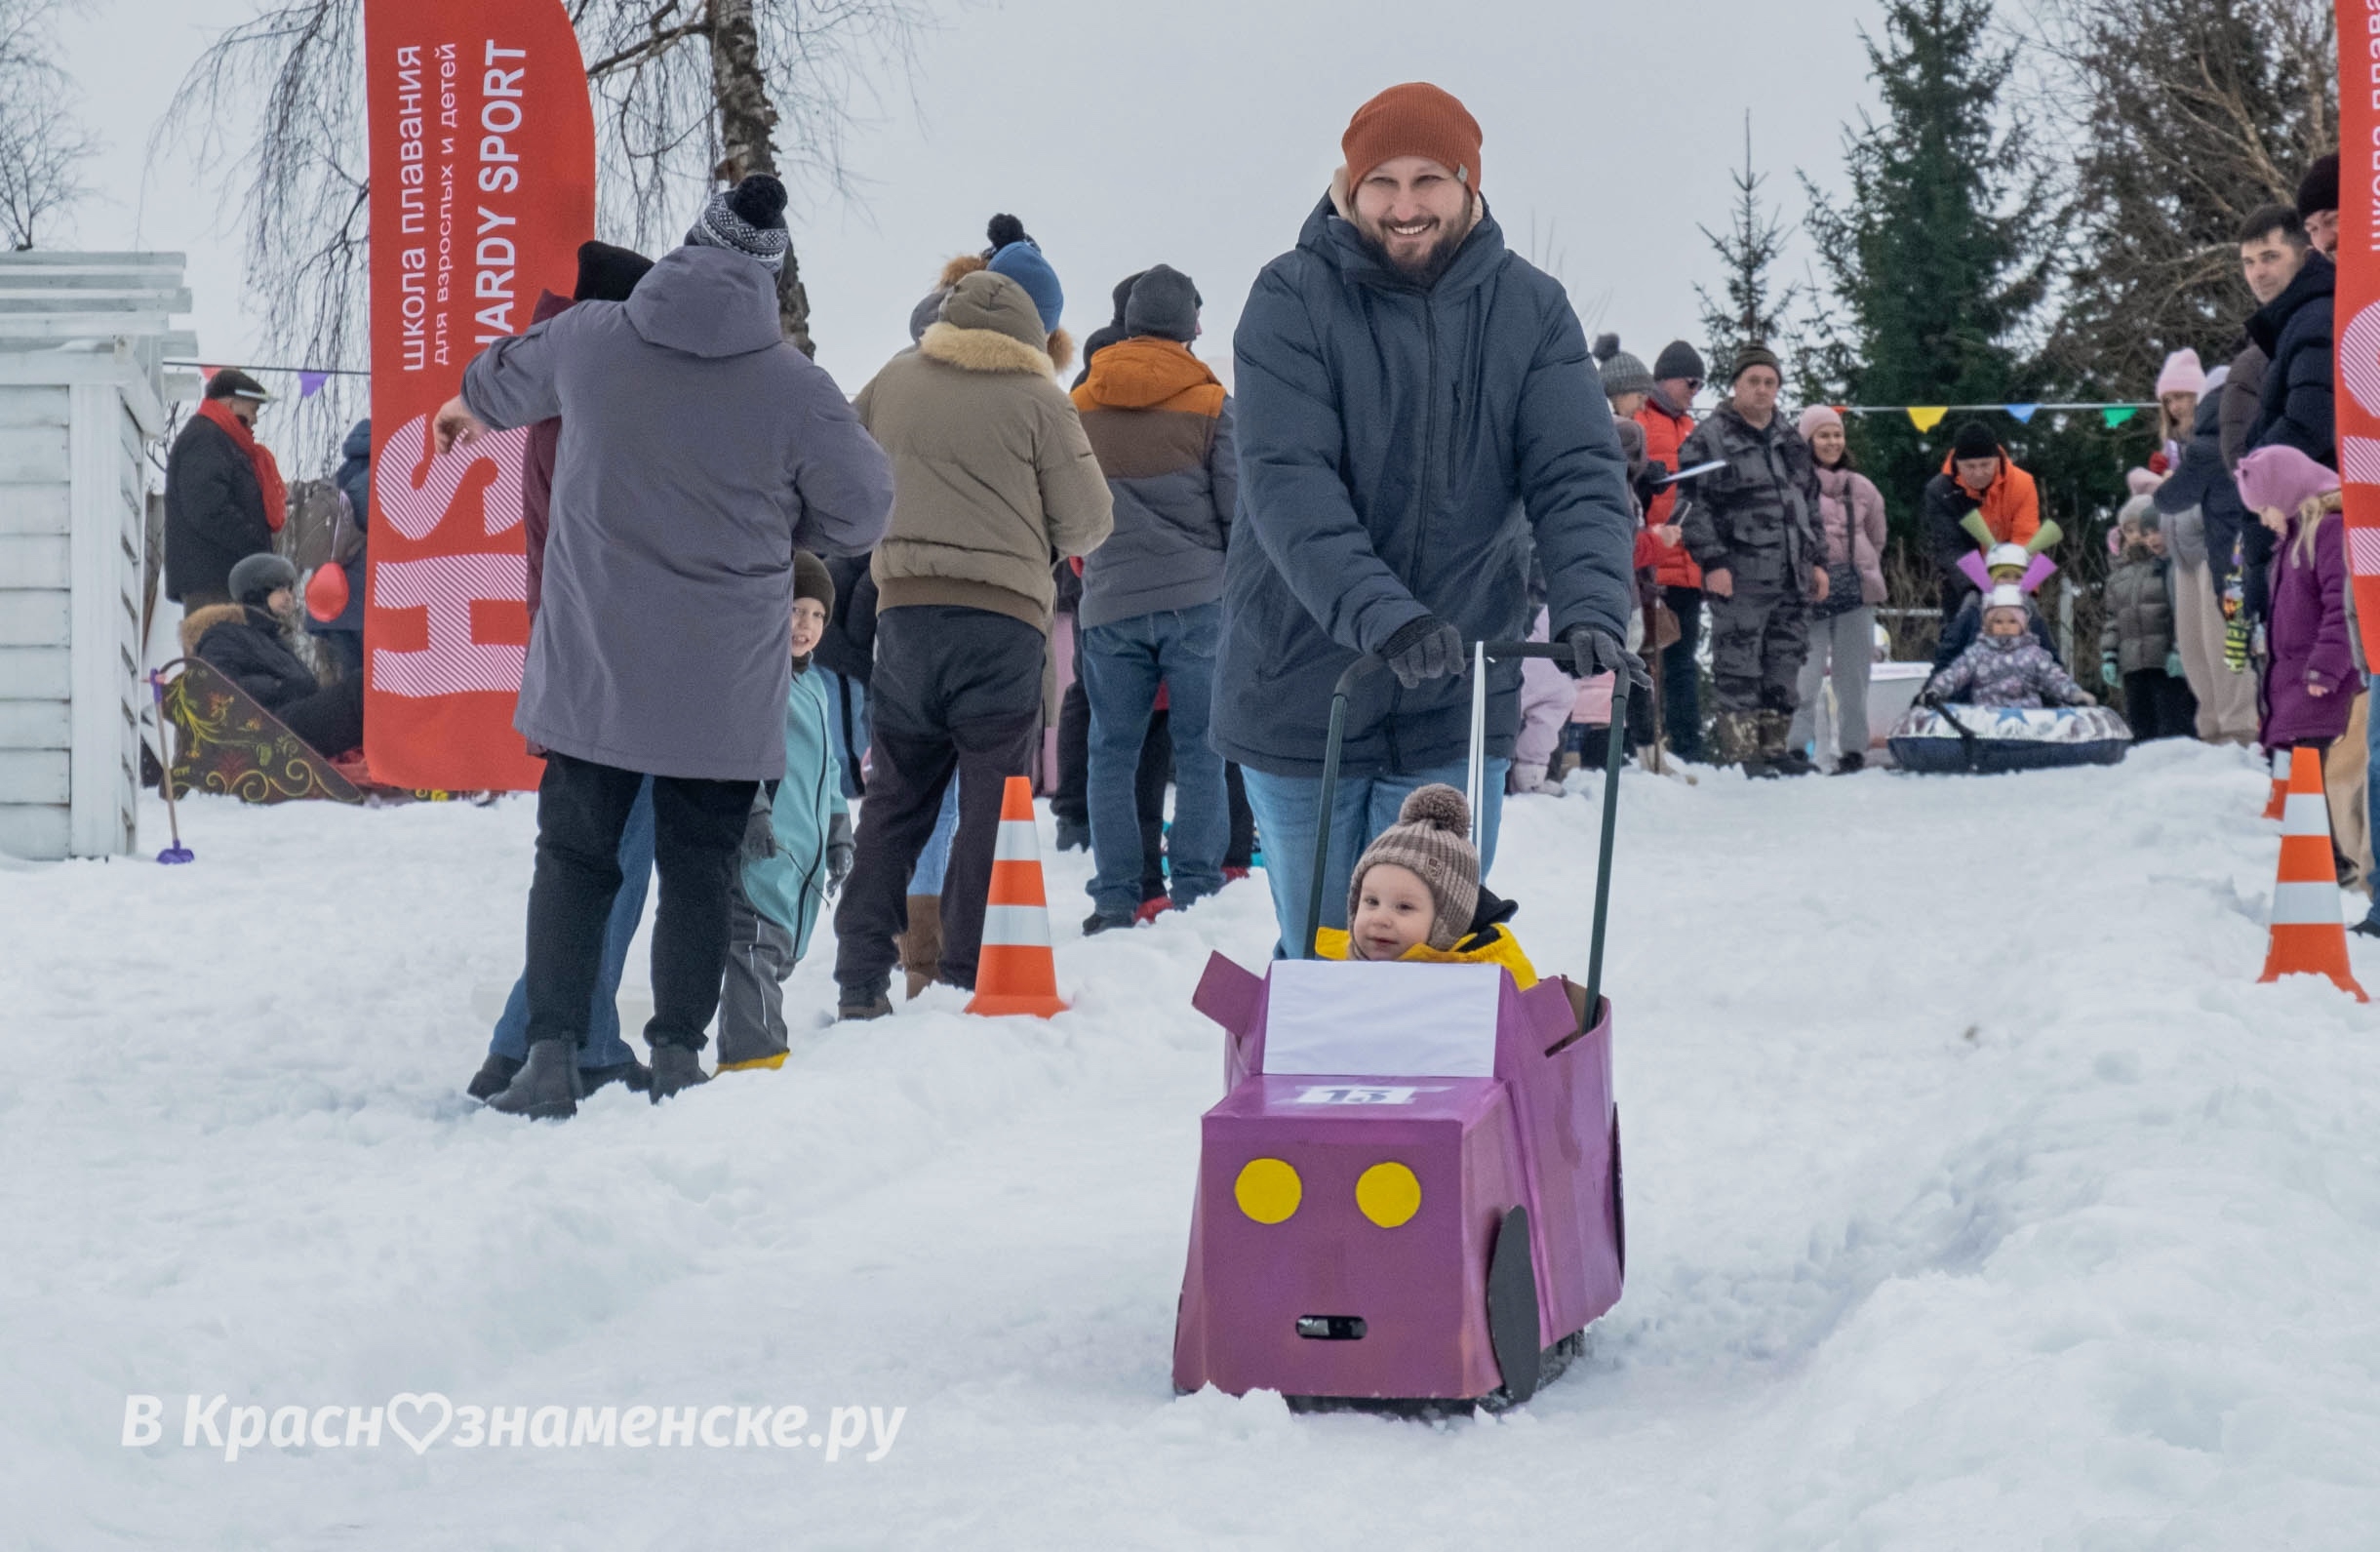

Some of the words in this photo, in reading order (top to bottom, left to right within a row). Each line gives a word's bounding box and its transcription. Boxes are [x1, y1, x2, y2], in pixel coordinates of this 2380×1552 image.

[396, 45, 424, 234] плавания
[434, 42, 456, 128] детей
[441, 138, 455, 154] и
[477, 39, 527, 194] SPORT
[436, 164, 454, 302] взрослых
[474, 206, 517, 345] ARDY
[402, 246, 425, 372] школа
[434, 312, 449, 365] для
